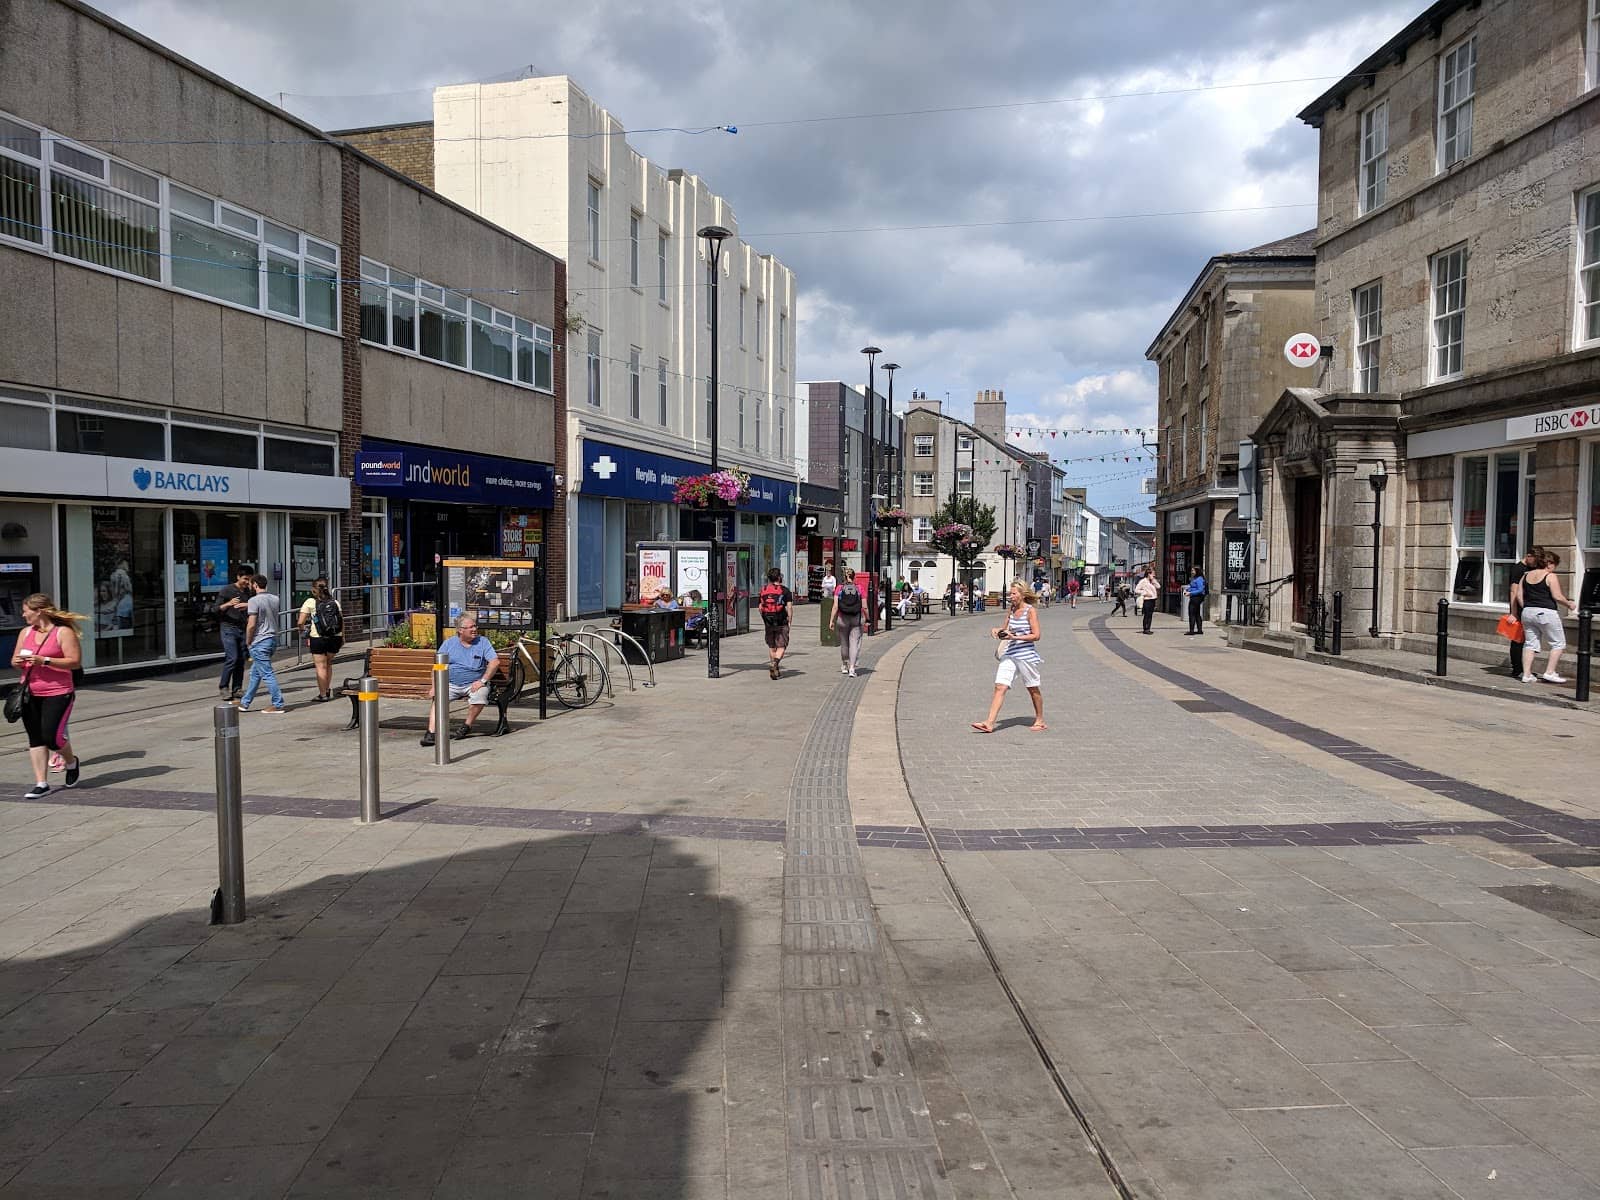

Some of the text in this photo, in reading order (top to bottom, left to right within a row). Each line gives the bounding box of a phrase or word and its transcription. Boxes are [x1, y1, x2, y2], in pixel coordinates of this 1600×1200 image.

[1534, 413, 1569, 433] HSBC
[361, 461, 400, 470] poundworld
[405, 459, 470, 487] undworld
[154, 471, 230, 492] BARCLAYS
[802, 516, 817, 528] JD
[503, 529, 523, 542] STORE
[524, 543, 540, 558] STOR
[643, 565, 666, 578] COOL
